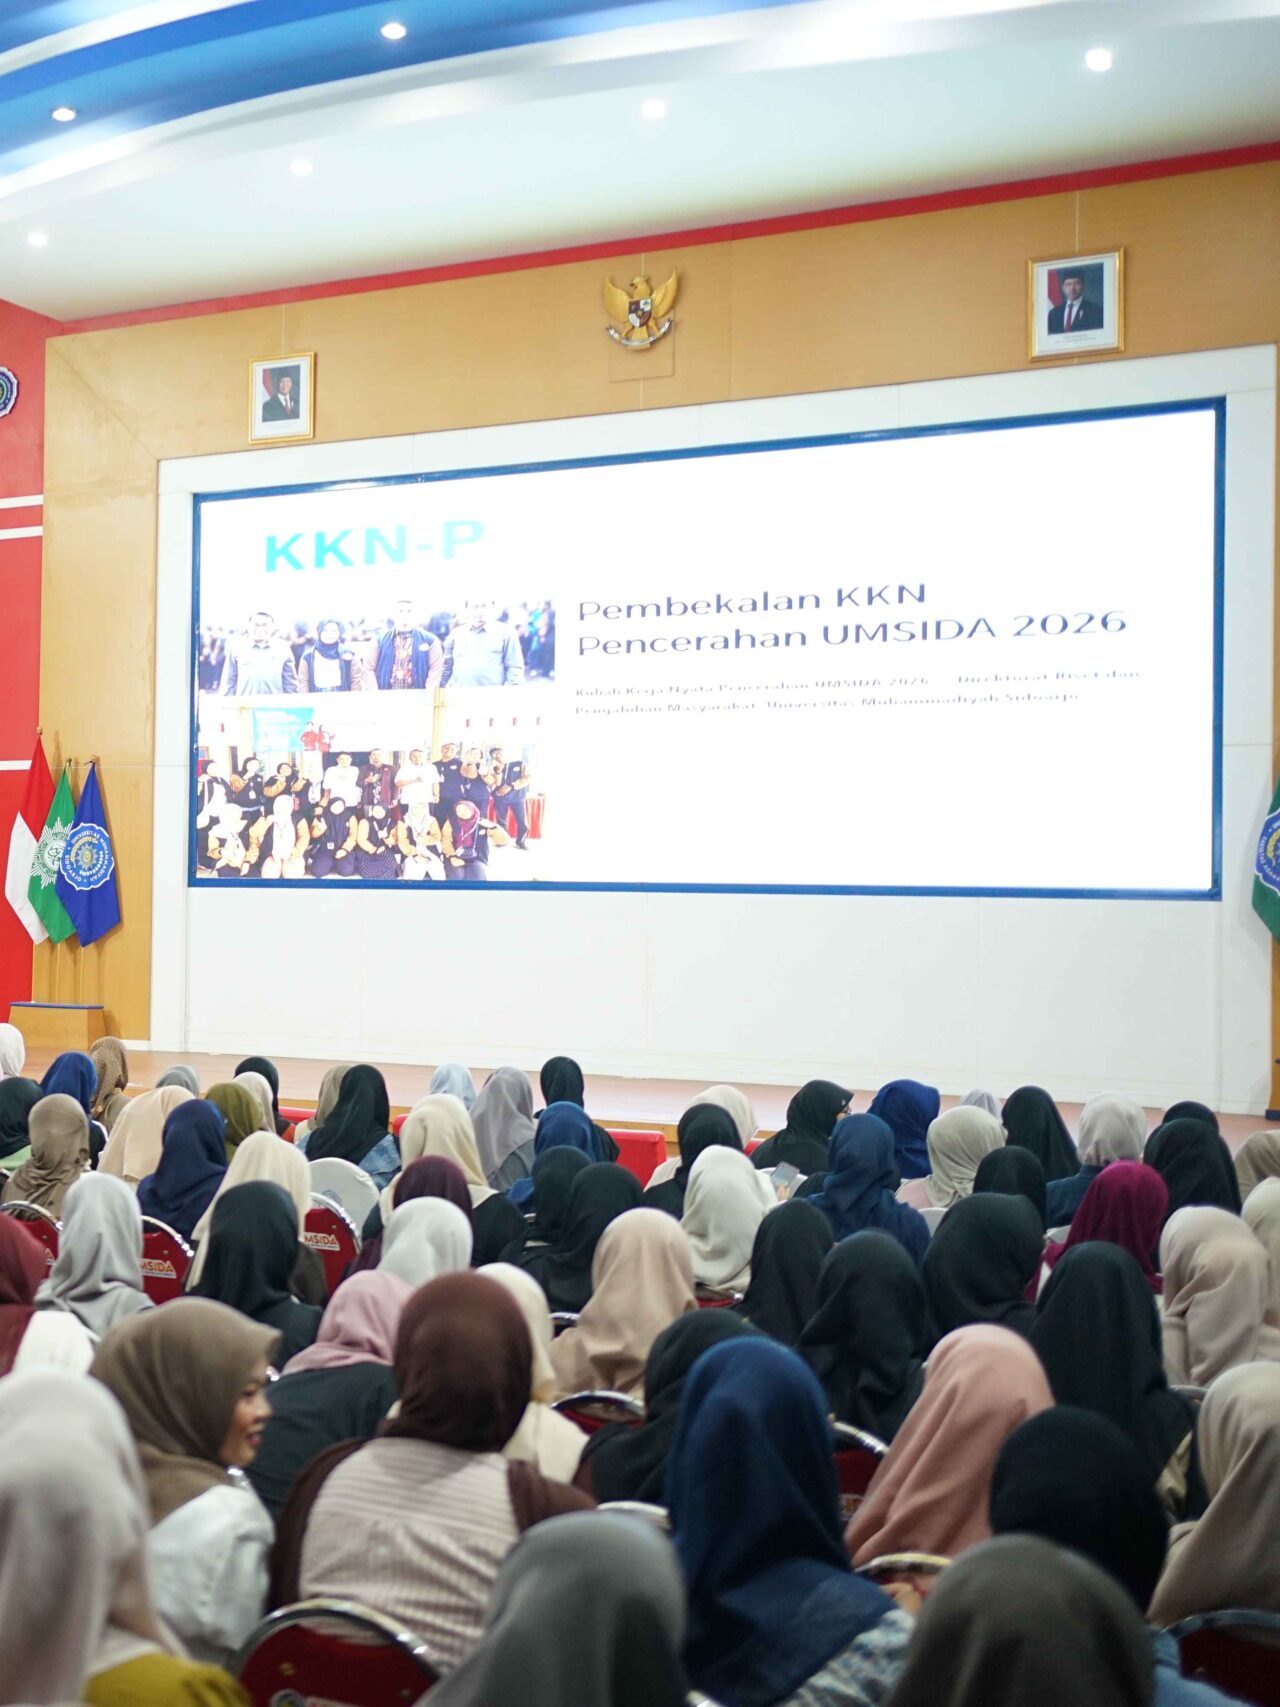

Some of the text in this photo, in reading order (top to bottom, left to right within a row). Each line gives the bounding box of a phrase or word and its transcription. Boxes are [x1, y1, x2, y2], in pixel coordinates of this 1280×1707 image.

[265, 519, 485, 573] KKN-P
[579, 583, 925, 621] Pembekalan KKN
[579, 610, 1127, 656] Pencerahan UMSIDA 2026
[304, 1234, 338, 1246] MSIDA
